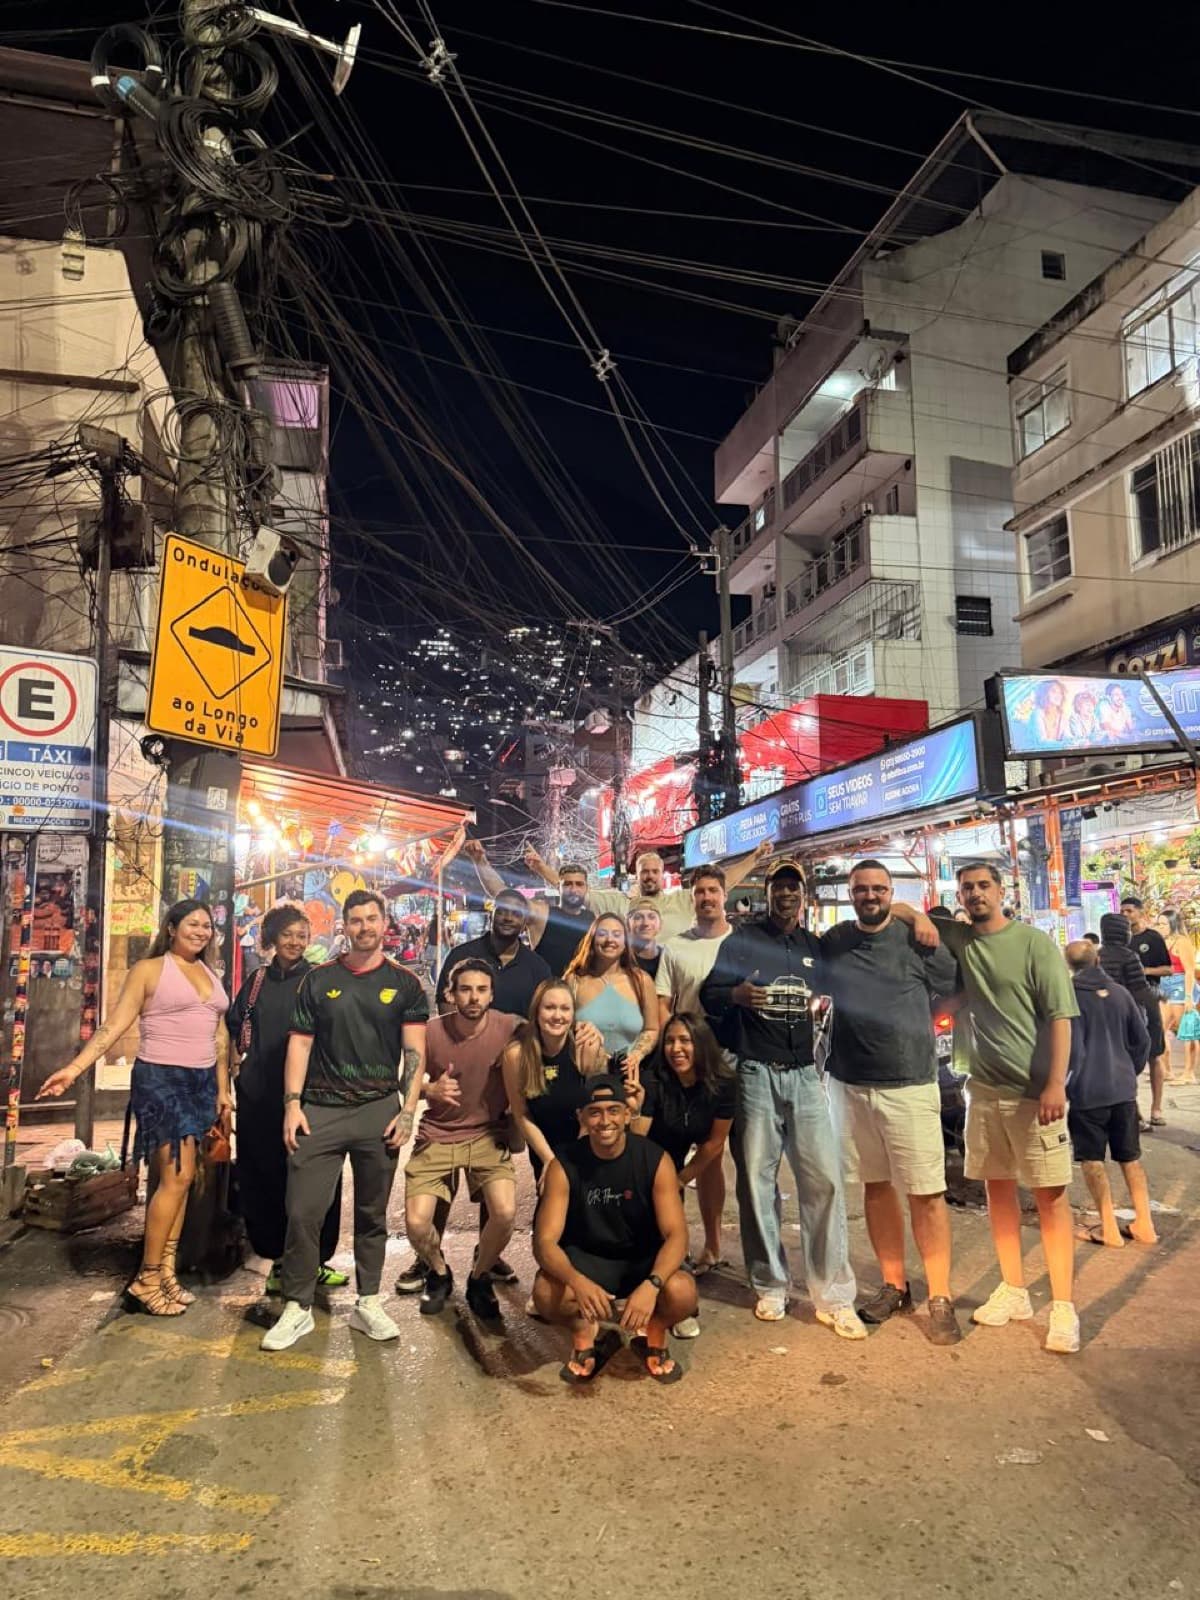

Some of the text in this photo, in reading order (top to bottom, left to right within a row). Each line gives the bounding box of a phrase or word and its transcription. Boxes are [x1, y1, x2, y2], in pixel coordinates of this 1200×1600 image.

[17, 678, 55, 721] E
[172, 697, 259, 730] ao Longo
[184, 717, 244, 744] da Via
[28, 745, 72, 764] TÁXI
[38, 768, 91, 781] VEÍCULOS
[25, 782, 39, 790] DE
[42, 783, 80, 793] PONTO
